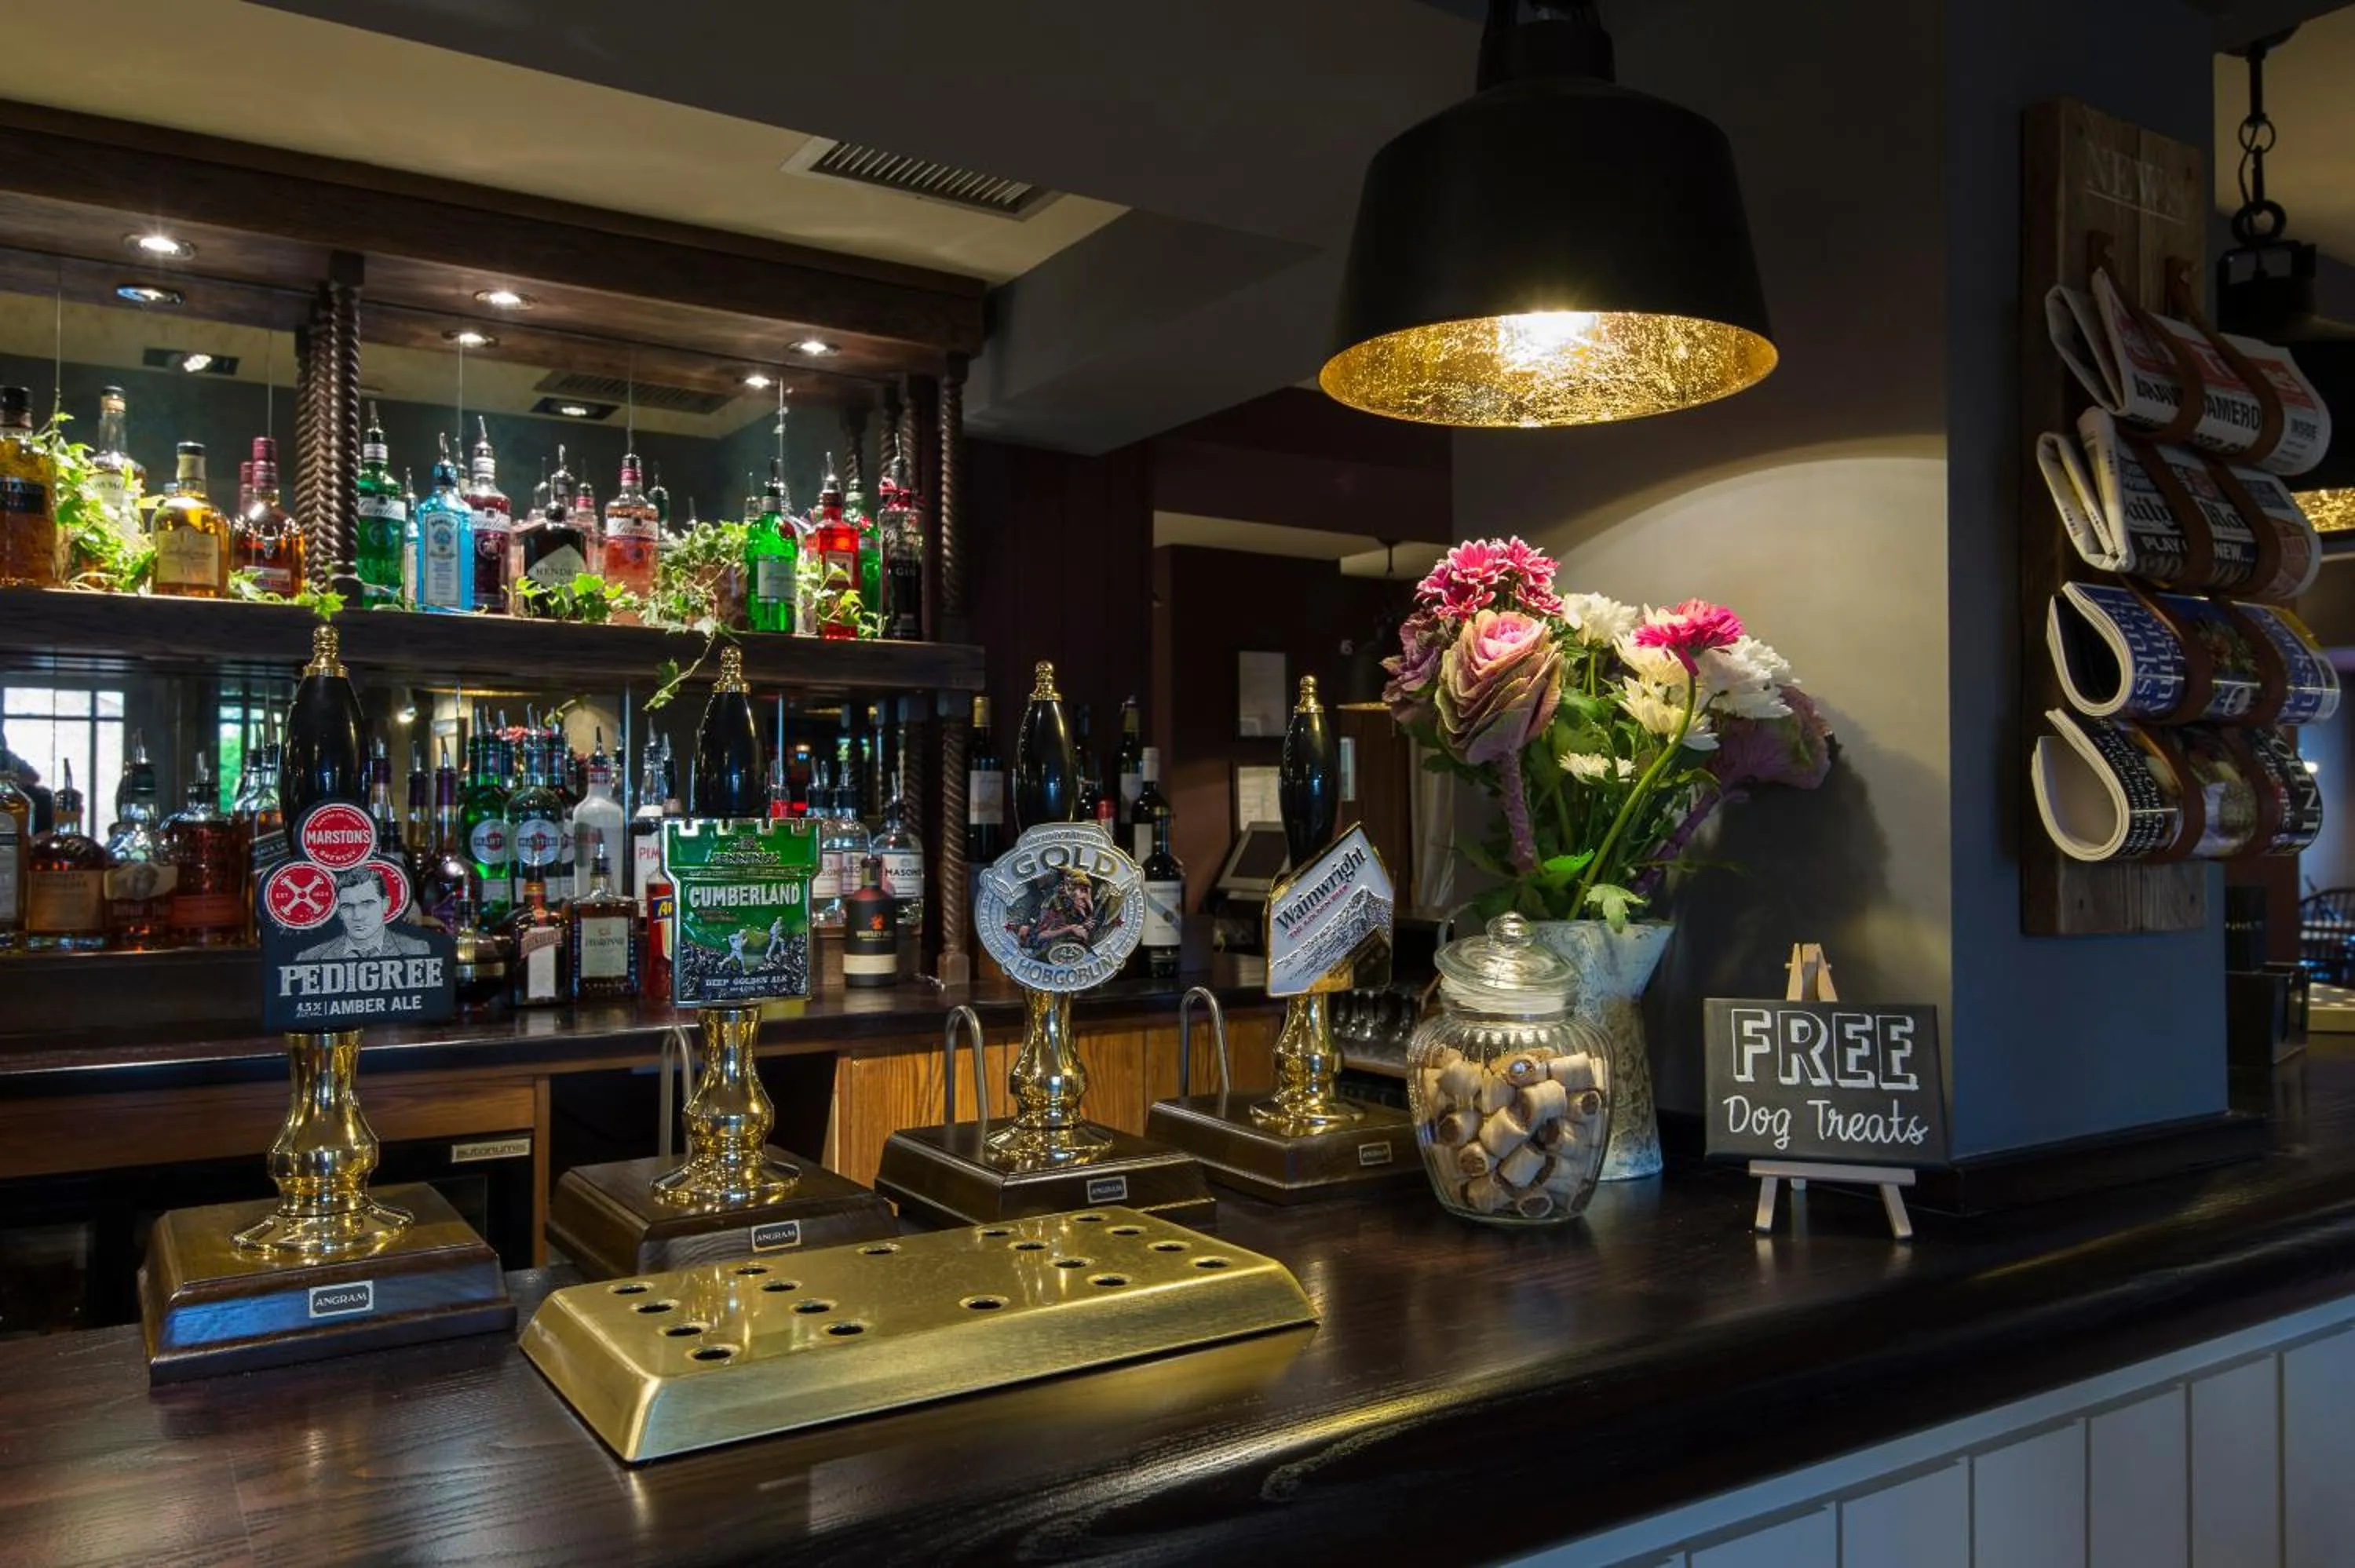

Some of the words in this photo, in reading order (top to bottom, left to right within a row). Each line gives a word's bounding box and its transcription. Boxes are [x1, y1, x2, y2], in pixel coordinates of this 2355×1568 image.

[306, 828, 371, 844] MARSTON'S
[1011, 844, 1120, 879] GOLD
[688, 881, 801, 907] CUMBERLAND
[1275, 845, 1367, 931] Wainwright
[278, 957, 445, 997] PEDIGREE
[1016, 954, 1115, 986] HOBGOBLIN
[330, 997, 386, 1015] AMBER
[391, 995, 422, 1011] ALE
[1731, 1008, 1920, 1091] FREE
[1722, 1095, 1792, 1150] Dog
[1806, 1099, 1930, 1146] Treats
[316, 1292, 367, 1307] ANGRAM
